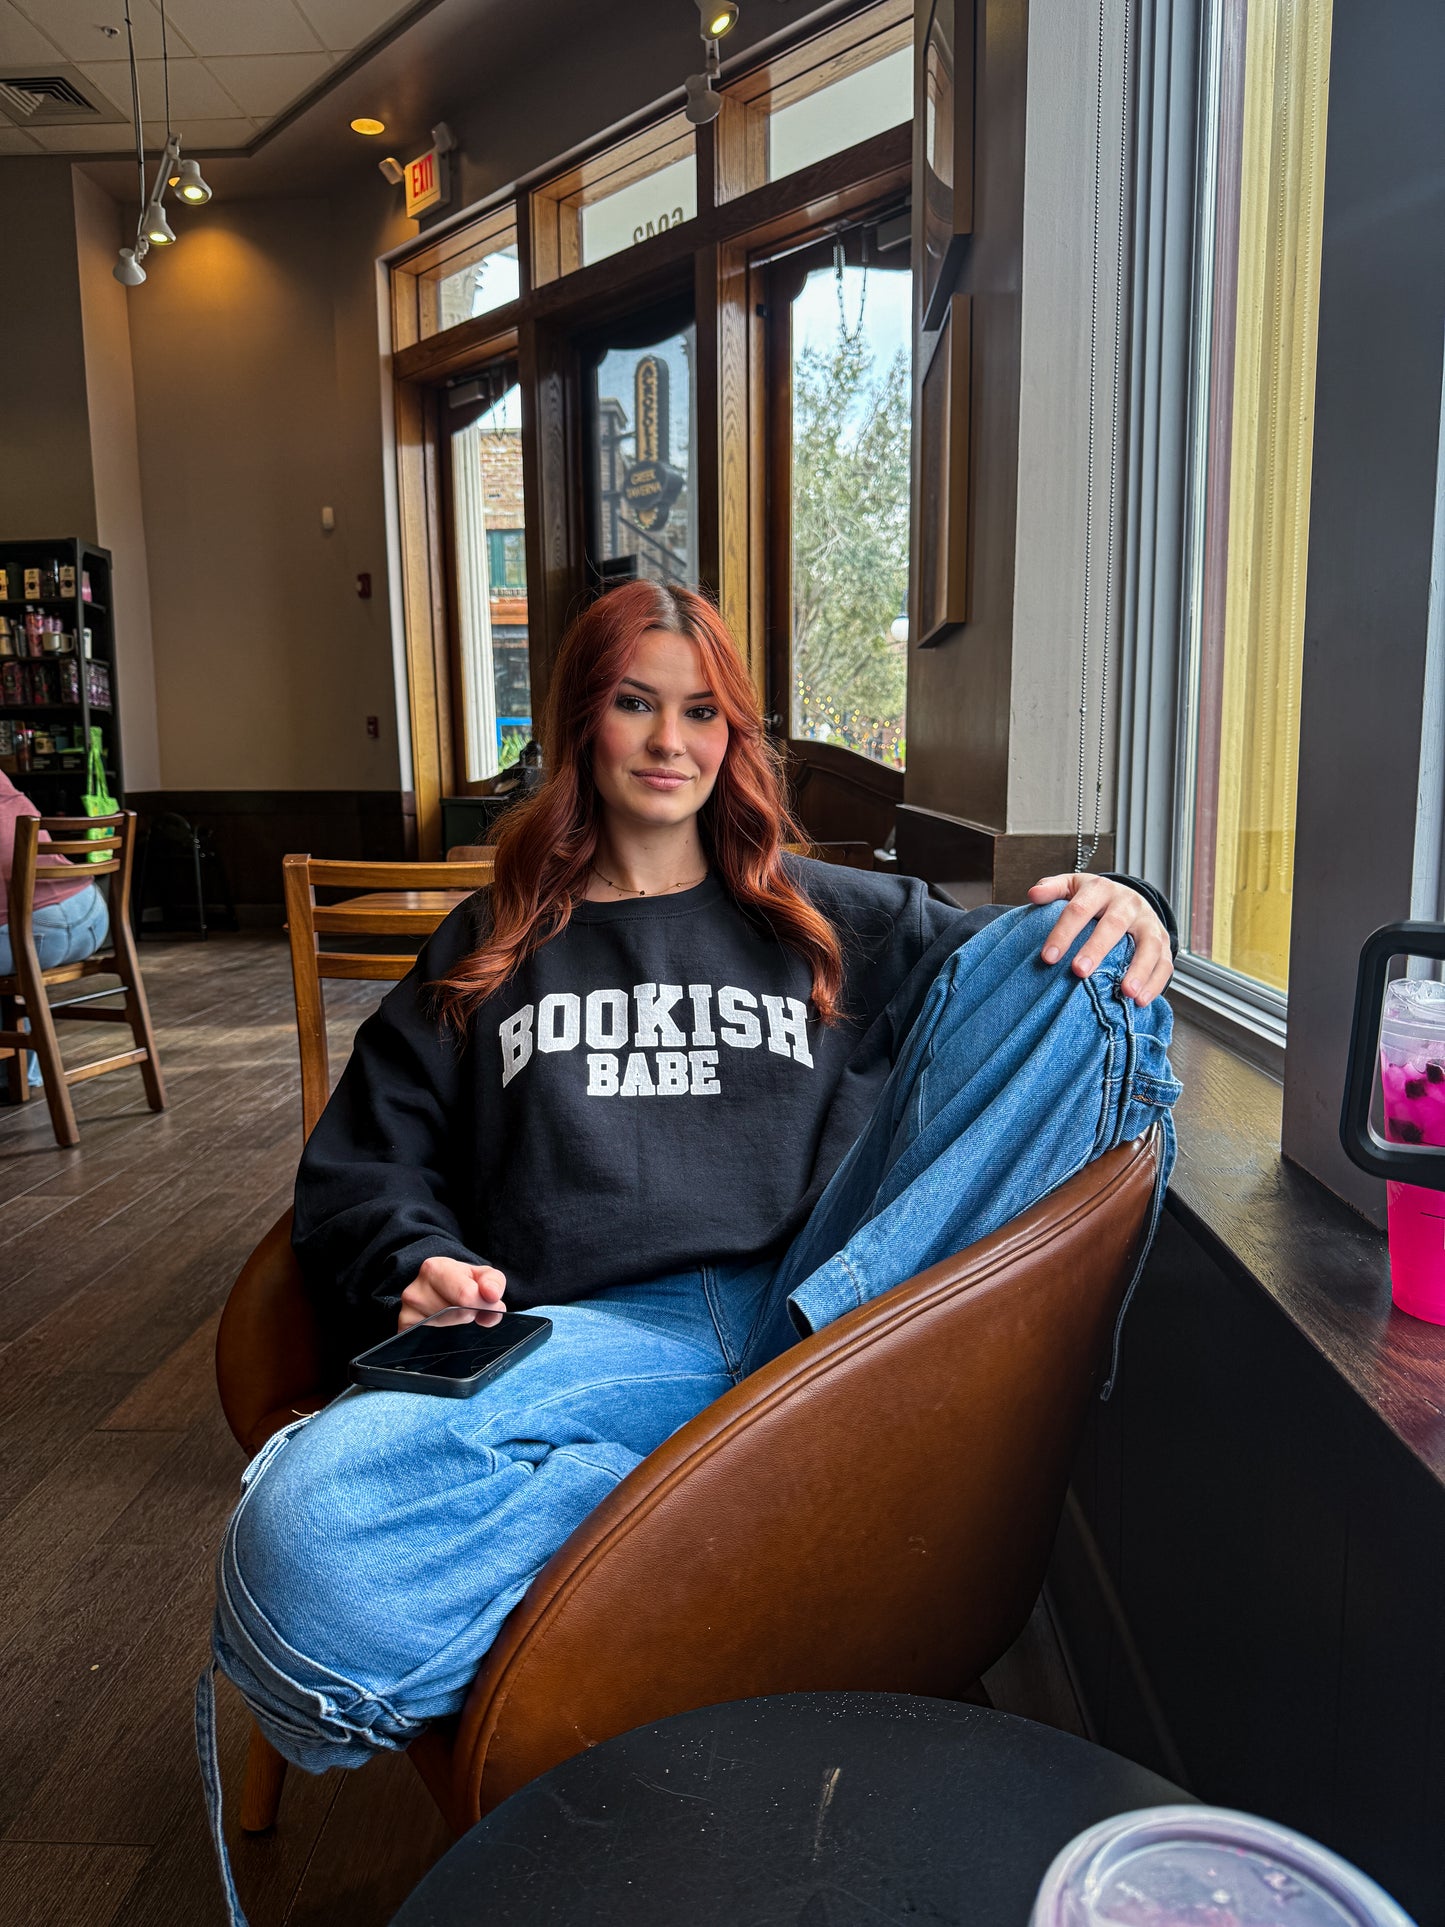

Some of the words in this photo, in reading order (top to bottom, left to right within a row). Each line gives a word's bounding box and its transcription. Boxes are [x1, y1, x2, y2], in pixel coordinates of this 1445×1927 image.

[412, 153, 433, 198] EXIT
[626, 482, 662, 499] TAVERNA
[631, 469, 656, 485] GREEK
[499, 983, 814, 1088] BOOKISH
[587, 1050, 721, 1096] BABE
